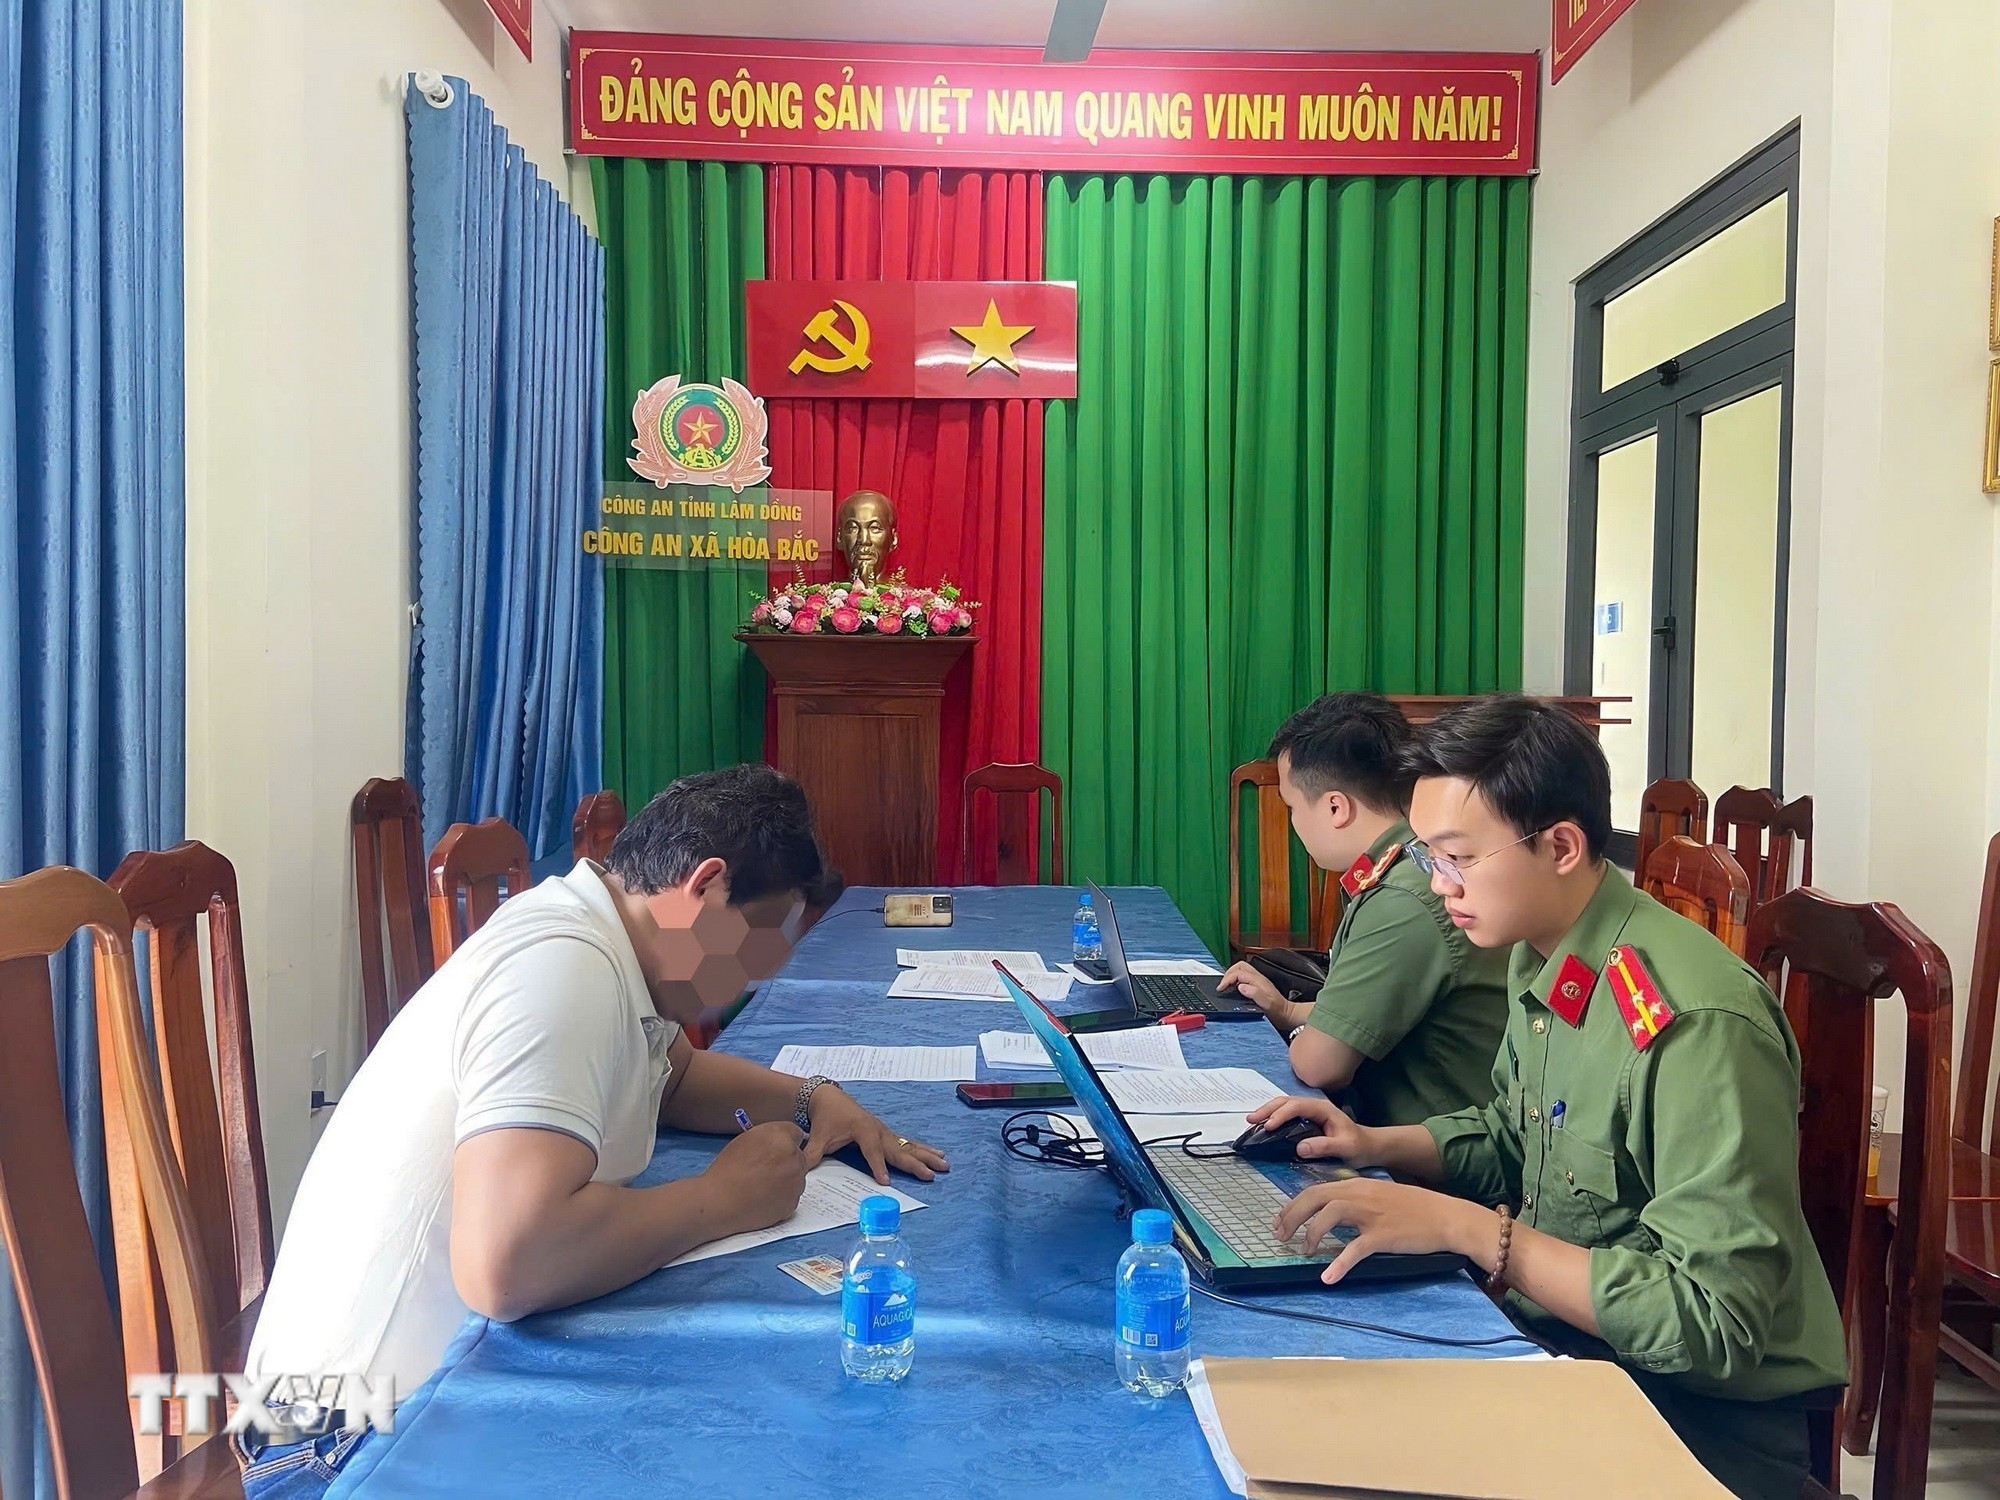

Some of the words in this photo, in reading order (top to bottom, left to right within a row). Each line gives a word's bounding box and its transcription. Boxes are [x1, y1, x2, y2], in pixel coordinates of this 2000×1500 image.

[599, 57, 697, 126] ĐẢNG
[707, 67, 803, 138] CỘNG
[812, 66, 883, 132] SẢN
[894, 74, 974, 145] VIỆT
[986, 89, 1064, 137] NAM
[1075, 91, 1192, 146] QUANG
[1204, 93, 1285, 141] VINH
[1298, 82, 1401, 142] MUÔN
[1411, 85, 1503, 143] NĂM!
[601, 494, 646, 515] CÔNG
[650, 499, 673, 517] AN
[679, 495, 716, 519] TỈNH
[721, 500, 754, 520] LÂM
[760, 498, 802, 522] ĐỒNG
[583, 526, 643, 556] CÔNG
[651, 532, 682, 557] AN
[690, 531, 721, 559] XÃ
[727, 532, 770, 561] HÒA
[777, 529, 819, 562] BẮC
